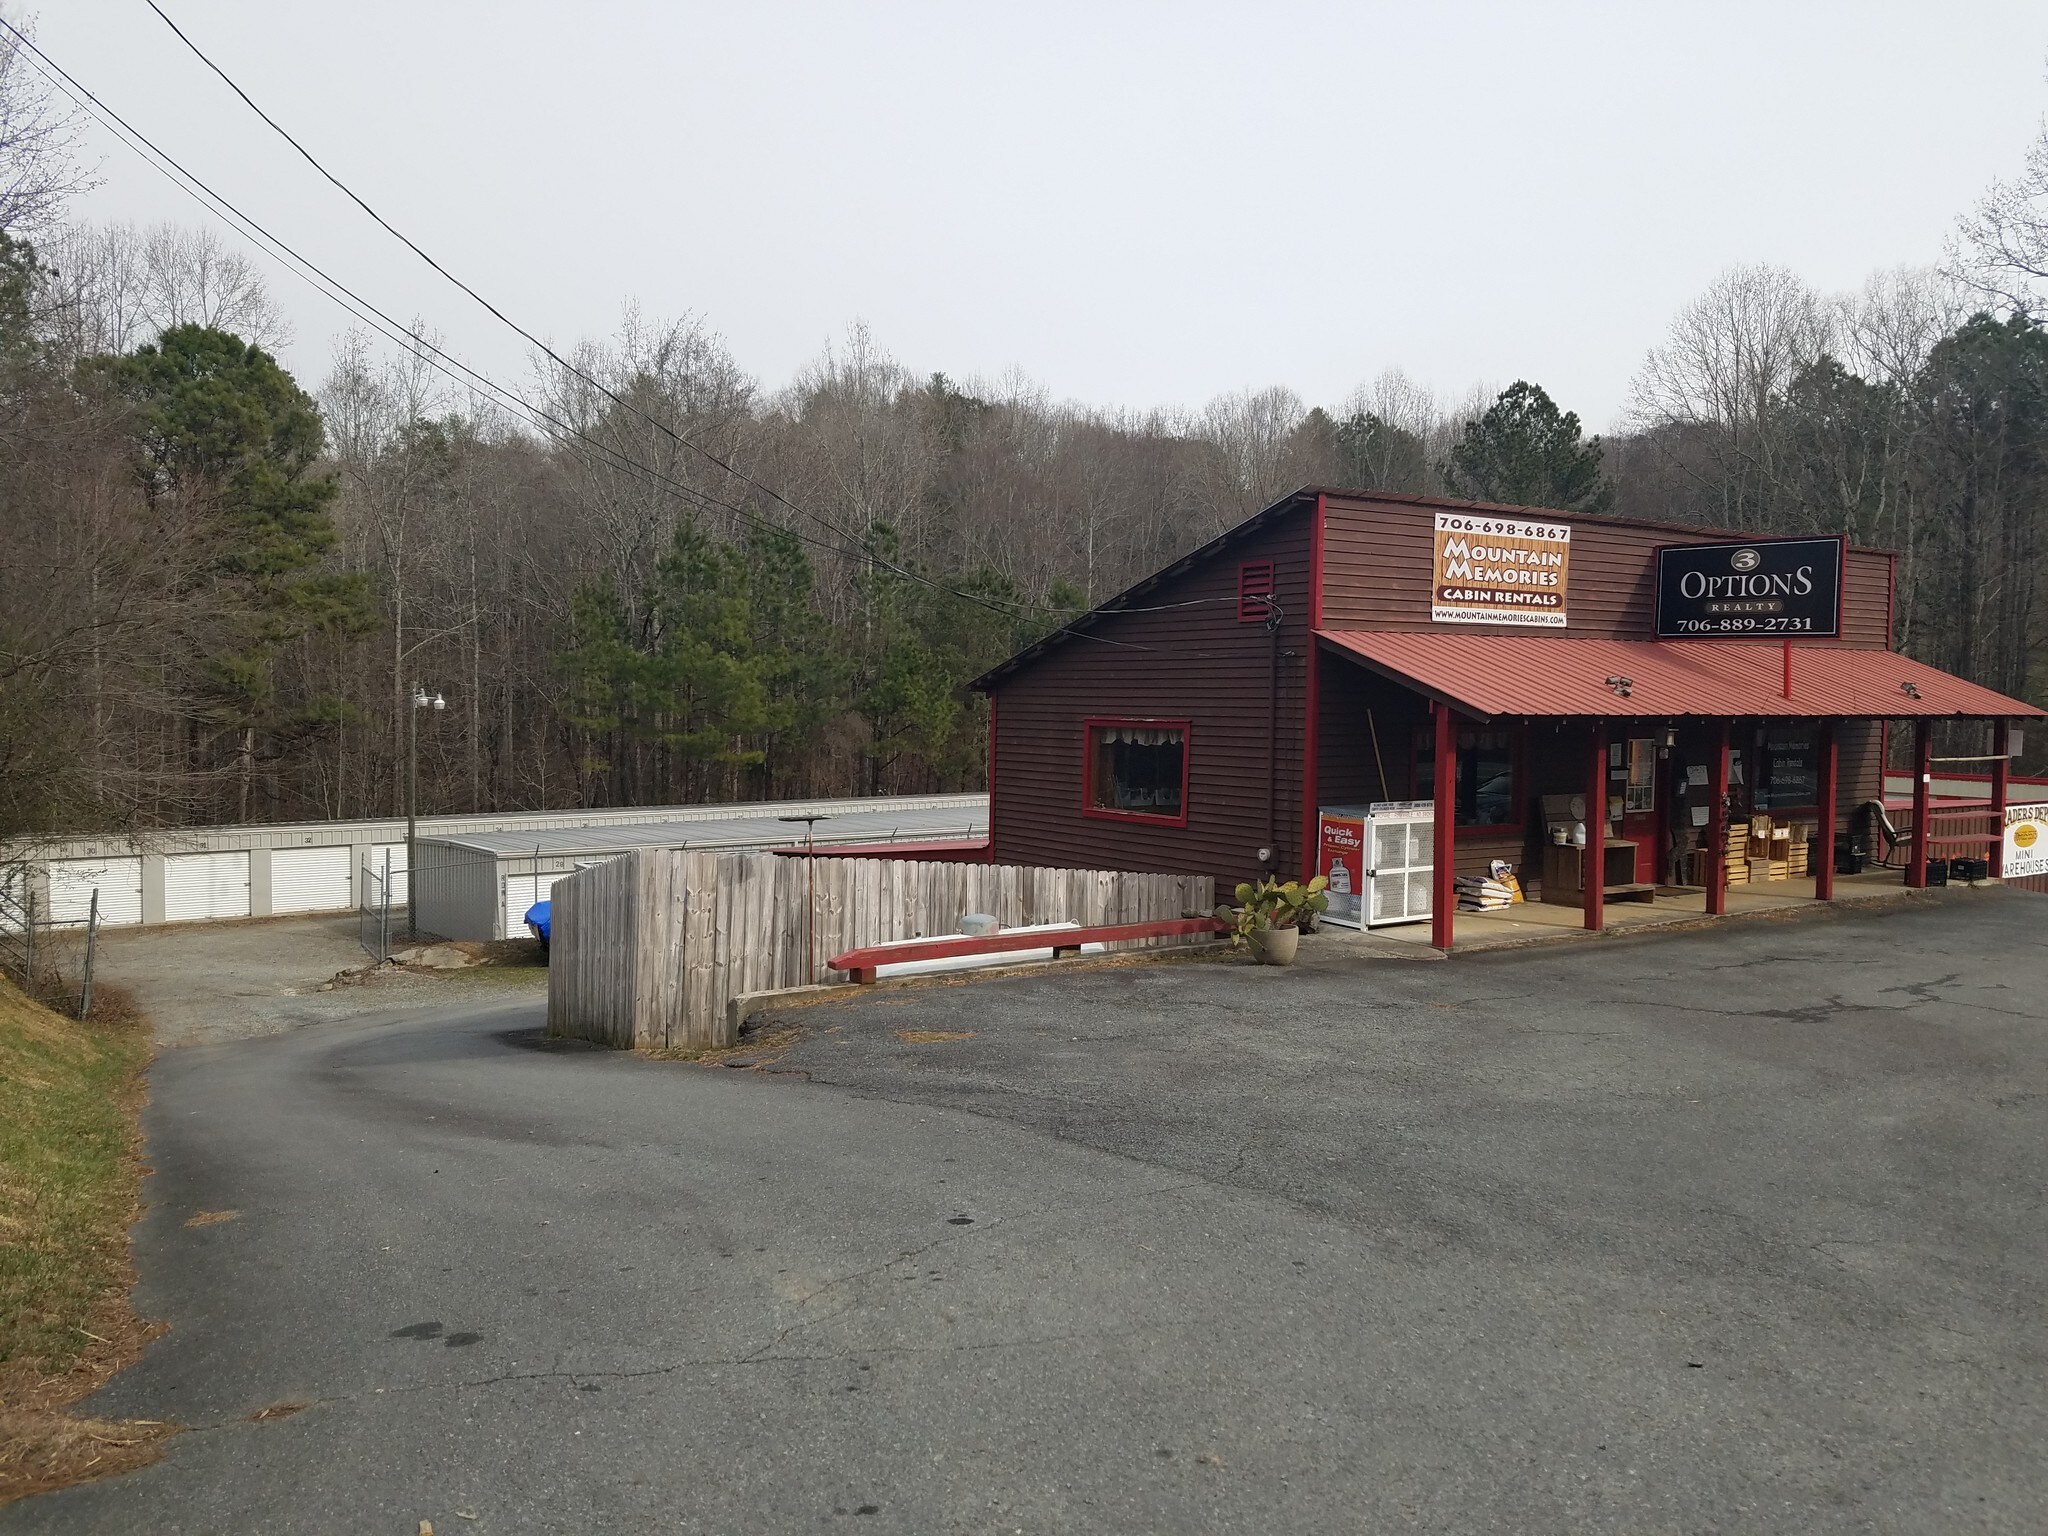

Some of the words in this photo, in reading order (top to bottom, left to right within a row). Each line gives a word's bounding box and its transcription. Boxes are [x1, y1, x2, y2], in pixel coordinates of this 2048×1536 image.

[1439, 516, 1568, 540] 706-698-6867
[1442, 535, 1562, 567] MOUNTAIN
[1735, 552, 1755, 567] 3
[1444, 557, 1558, 586] MEMORIES
[1680, 565, 1813, 599] OPTIONS
[1443, 588, 1491, 602] CABIN
[1495, 591, 1557, 605] RENTALS
[1711, 602, 1776, 612] REALTY
[1434, 609, 1565, 624] WWW.MOUNTAINMEMORIESCABINS.COM
[1677, 617, 1813, 632] 706-889-2731
[1324, 825, 1353, 837] Quick
[1335, 835, 1361, 848] Easy
[2015, 849, 2033, 860] MINI
